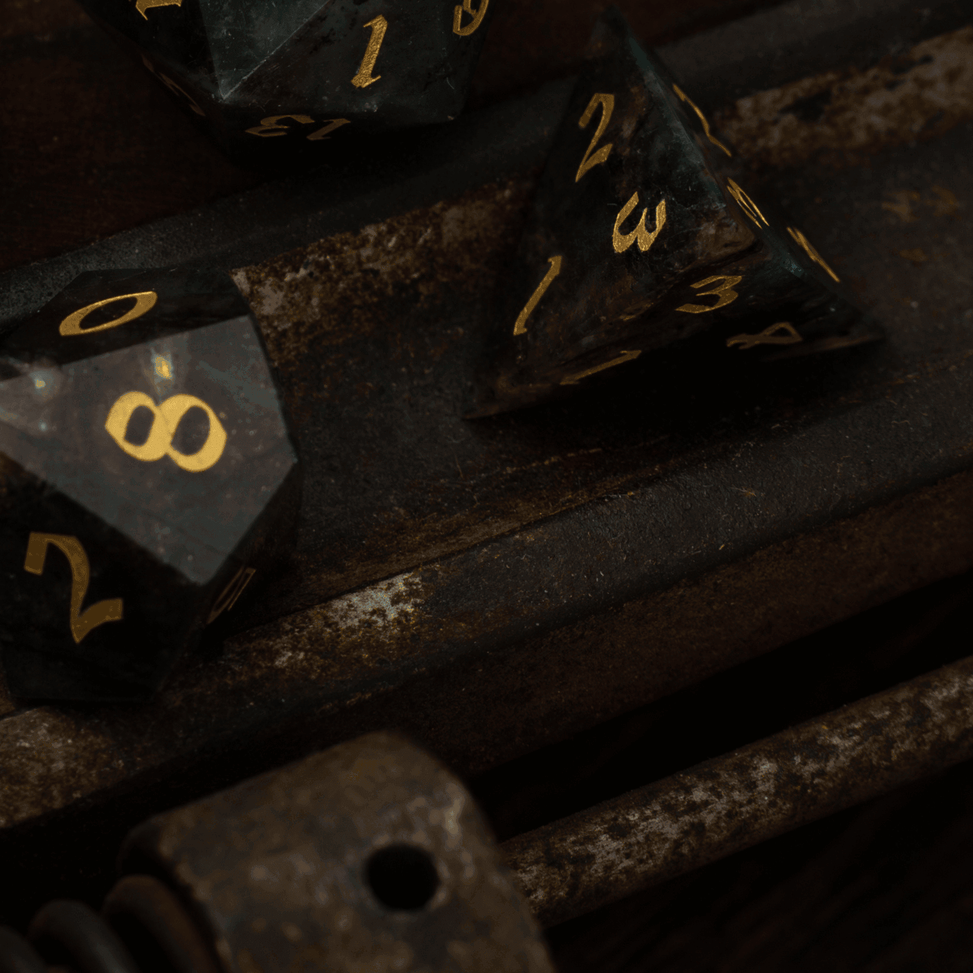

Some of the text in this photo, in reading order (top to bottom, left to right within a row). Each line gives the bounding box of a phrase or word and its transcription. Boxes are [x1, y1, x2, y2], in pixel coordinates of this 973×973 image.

[351, 15, 388, 88] 1
[575, 93, 614, 182] 2
[612, 192, 666, 253] 3
[59, 291, 158, 336] 0
[513, 255, 562, 336] 1
[676, 275, 742, 314] 3
[105, 391, 227, 472] 8
[24, 533, 123, 643] 2
